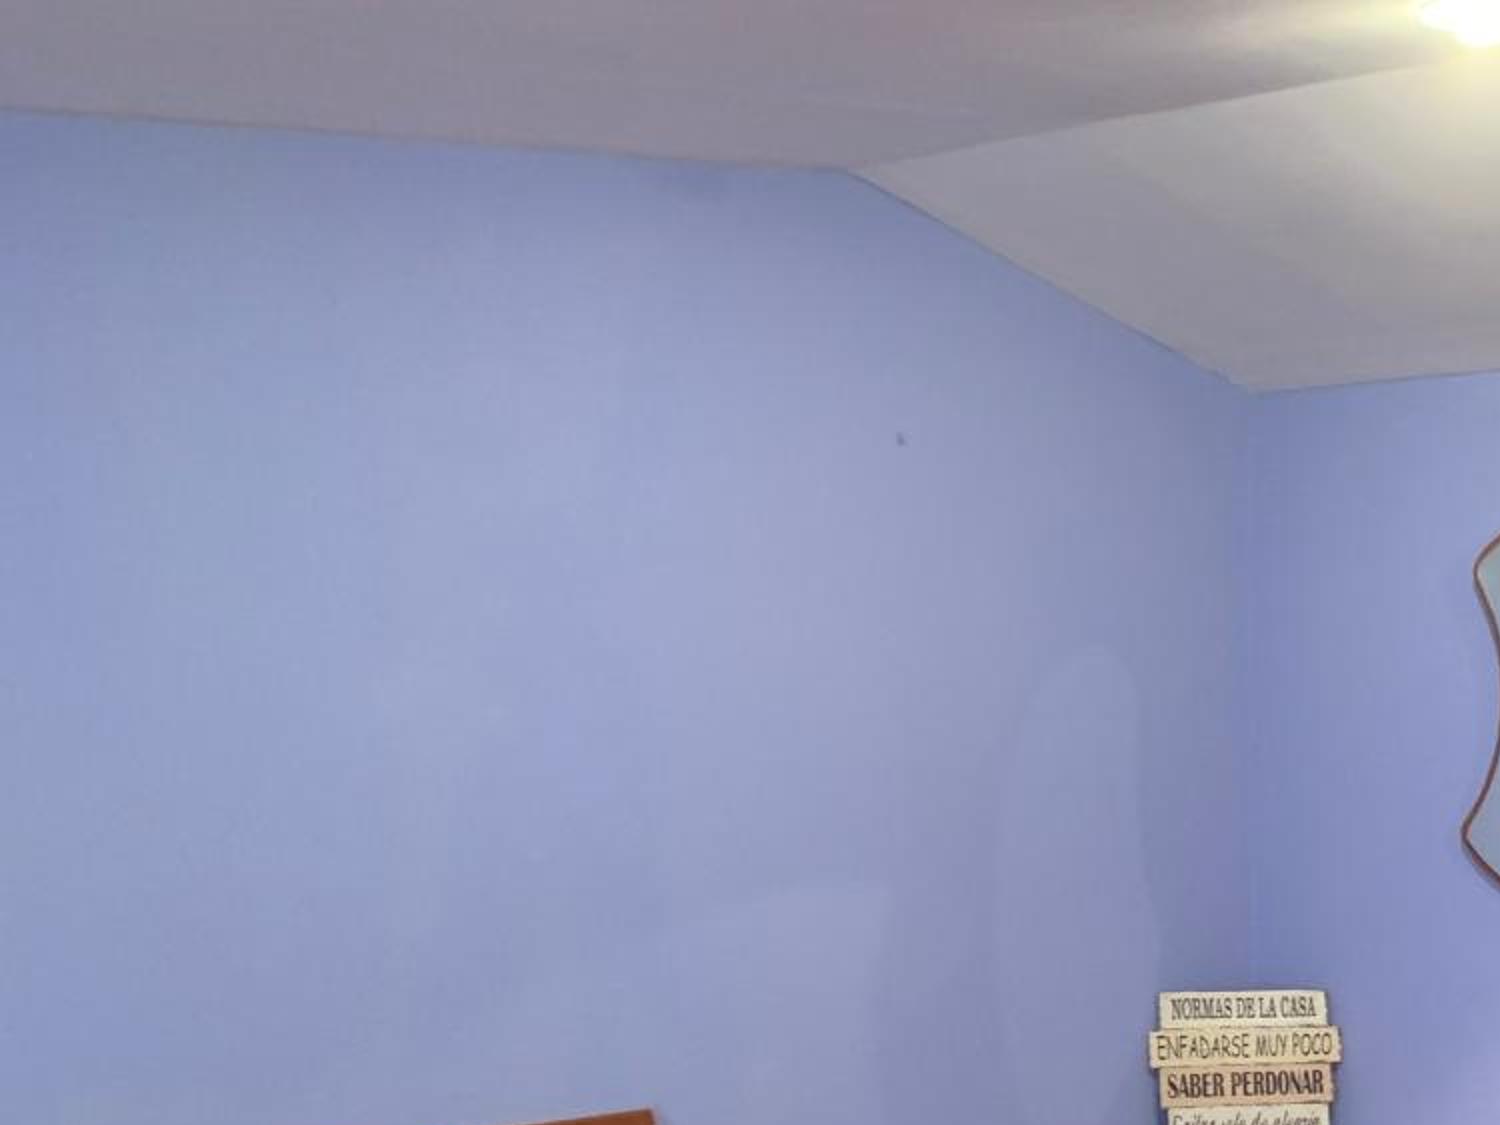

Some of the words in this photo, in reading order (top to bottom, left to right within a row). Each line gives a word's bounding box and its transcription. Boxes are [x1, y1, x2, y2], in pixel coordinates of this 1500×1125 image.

[1171, 997, 1232, 1020] NORMAS
[1236, 997, 1256, 1018] DE
[1259, 997, 1276, 1018] LA
[1280, 996, 1316, 1017] CASA
[1156, 1033, 1249, 1060] ENFADARSE
[1255, 1033, 1287, 1056] MUY
[1292, 1032, 1332, 1056] POCO
[1167, 1072, 1225, 1099] SABER
[1231, 1069, 1324, 1096] PERDONAR
